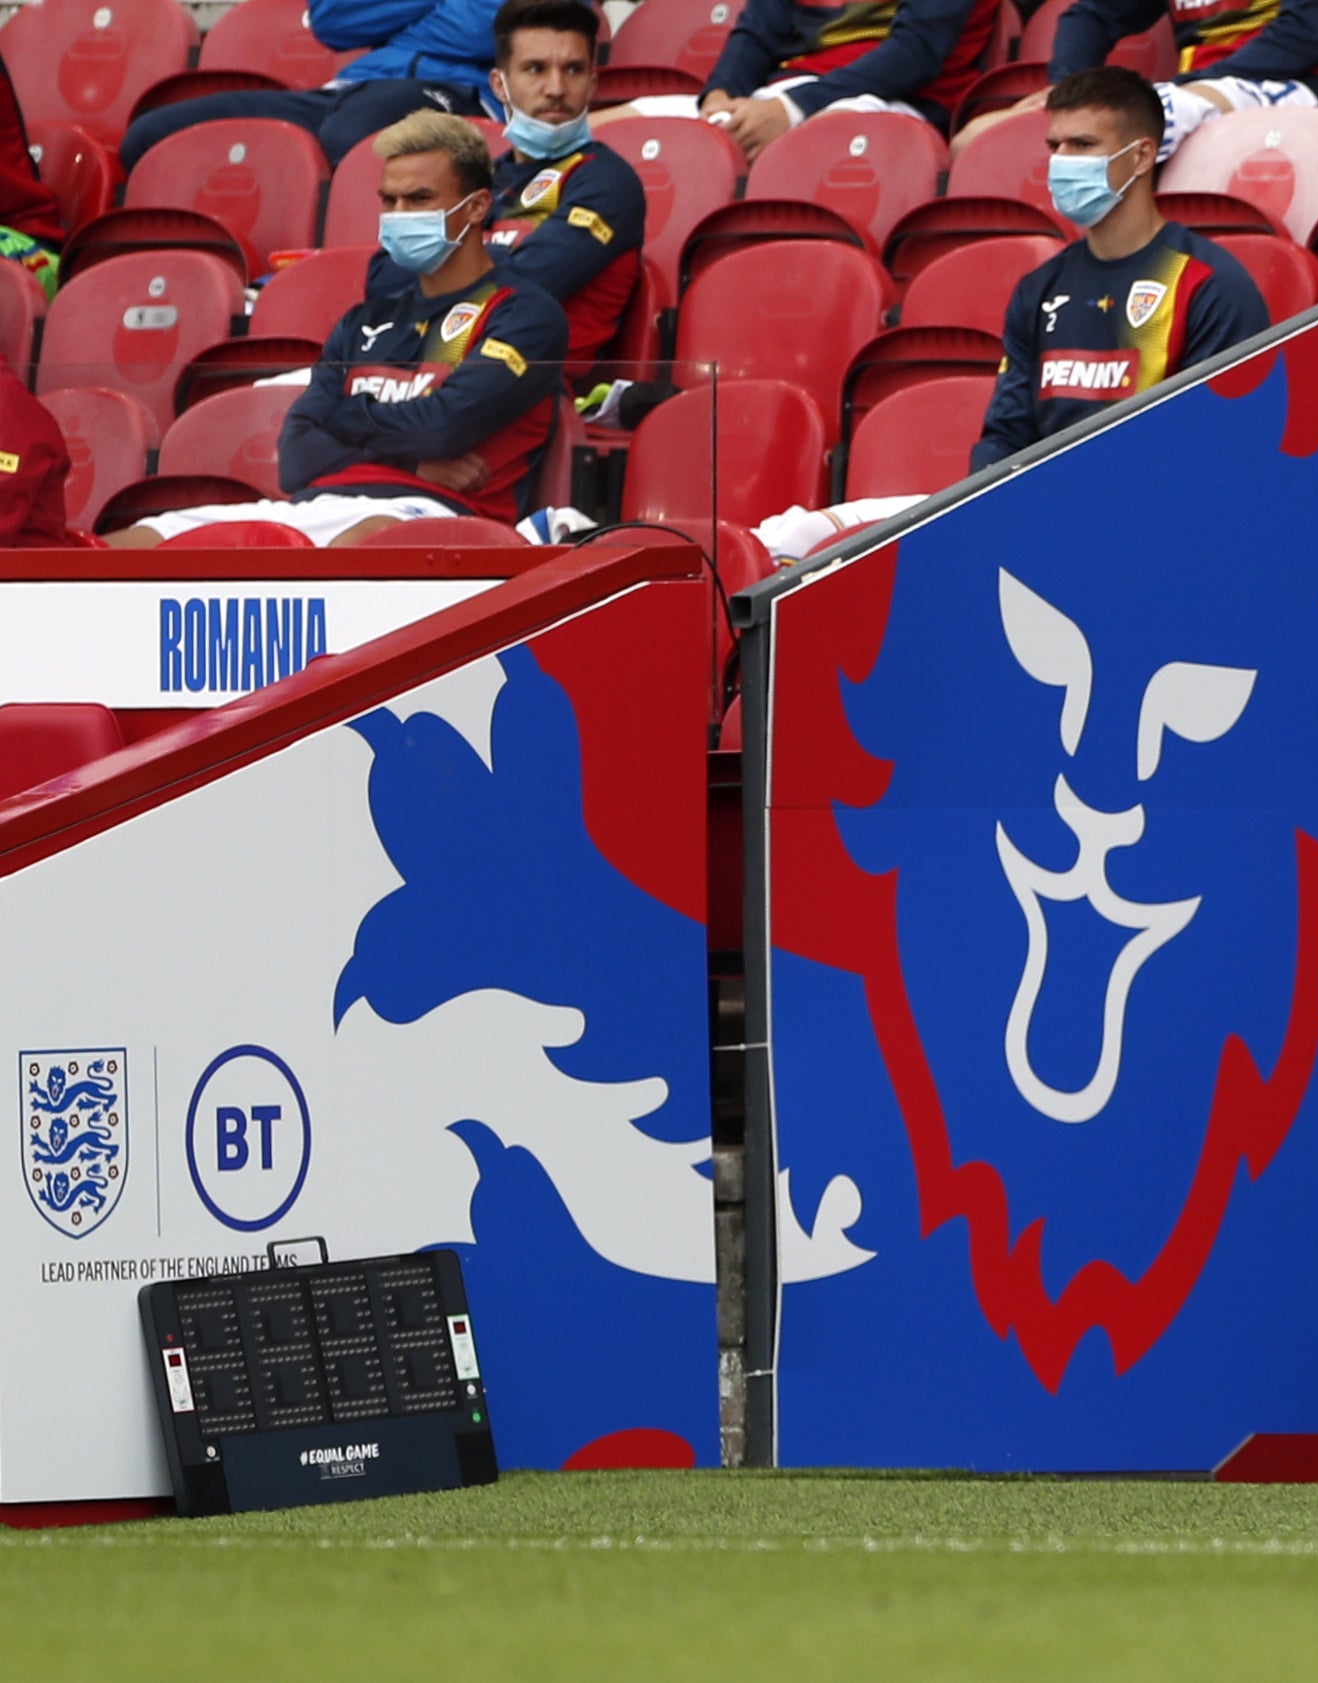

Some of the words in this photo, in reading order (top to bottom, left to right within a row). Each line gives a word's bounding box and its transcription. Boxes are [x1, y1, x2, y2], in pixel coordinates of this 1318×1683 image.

[1046, 312, 1057, 332] 2
[160, 598, 327, 692] ROMANIA
[217, 1105, 281, 1171] BT
[42, 1262, 75, 1283] LEAD
[78, 1260, 138, 1281] PARTNER
[140, 1259, 157, 1279] OF
[160, 1258, 185, 1279] THE
[188, 1256, 250, 1278] ENGLAND
[252, 1254, 298, 1271] TEMS
[300, 1447, 345, 1466] #EQUAL
[346, 1443, 380, 1461] GAME
